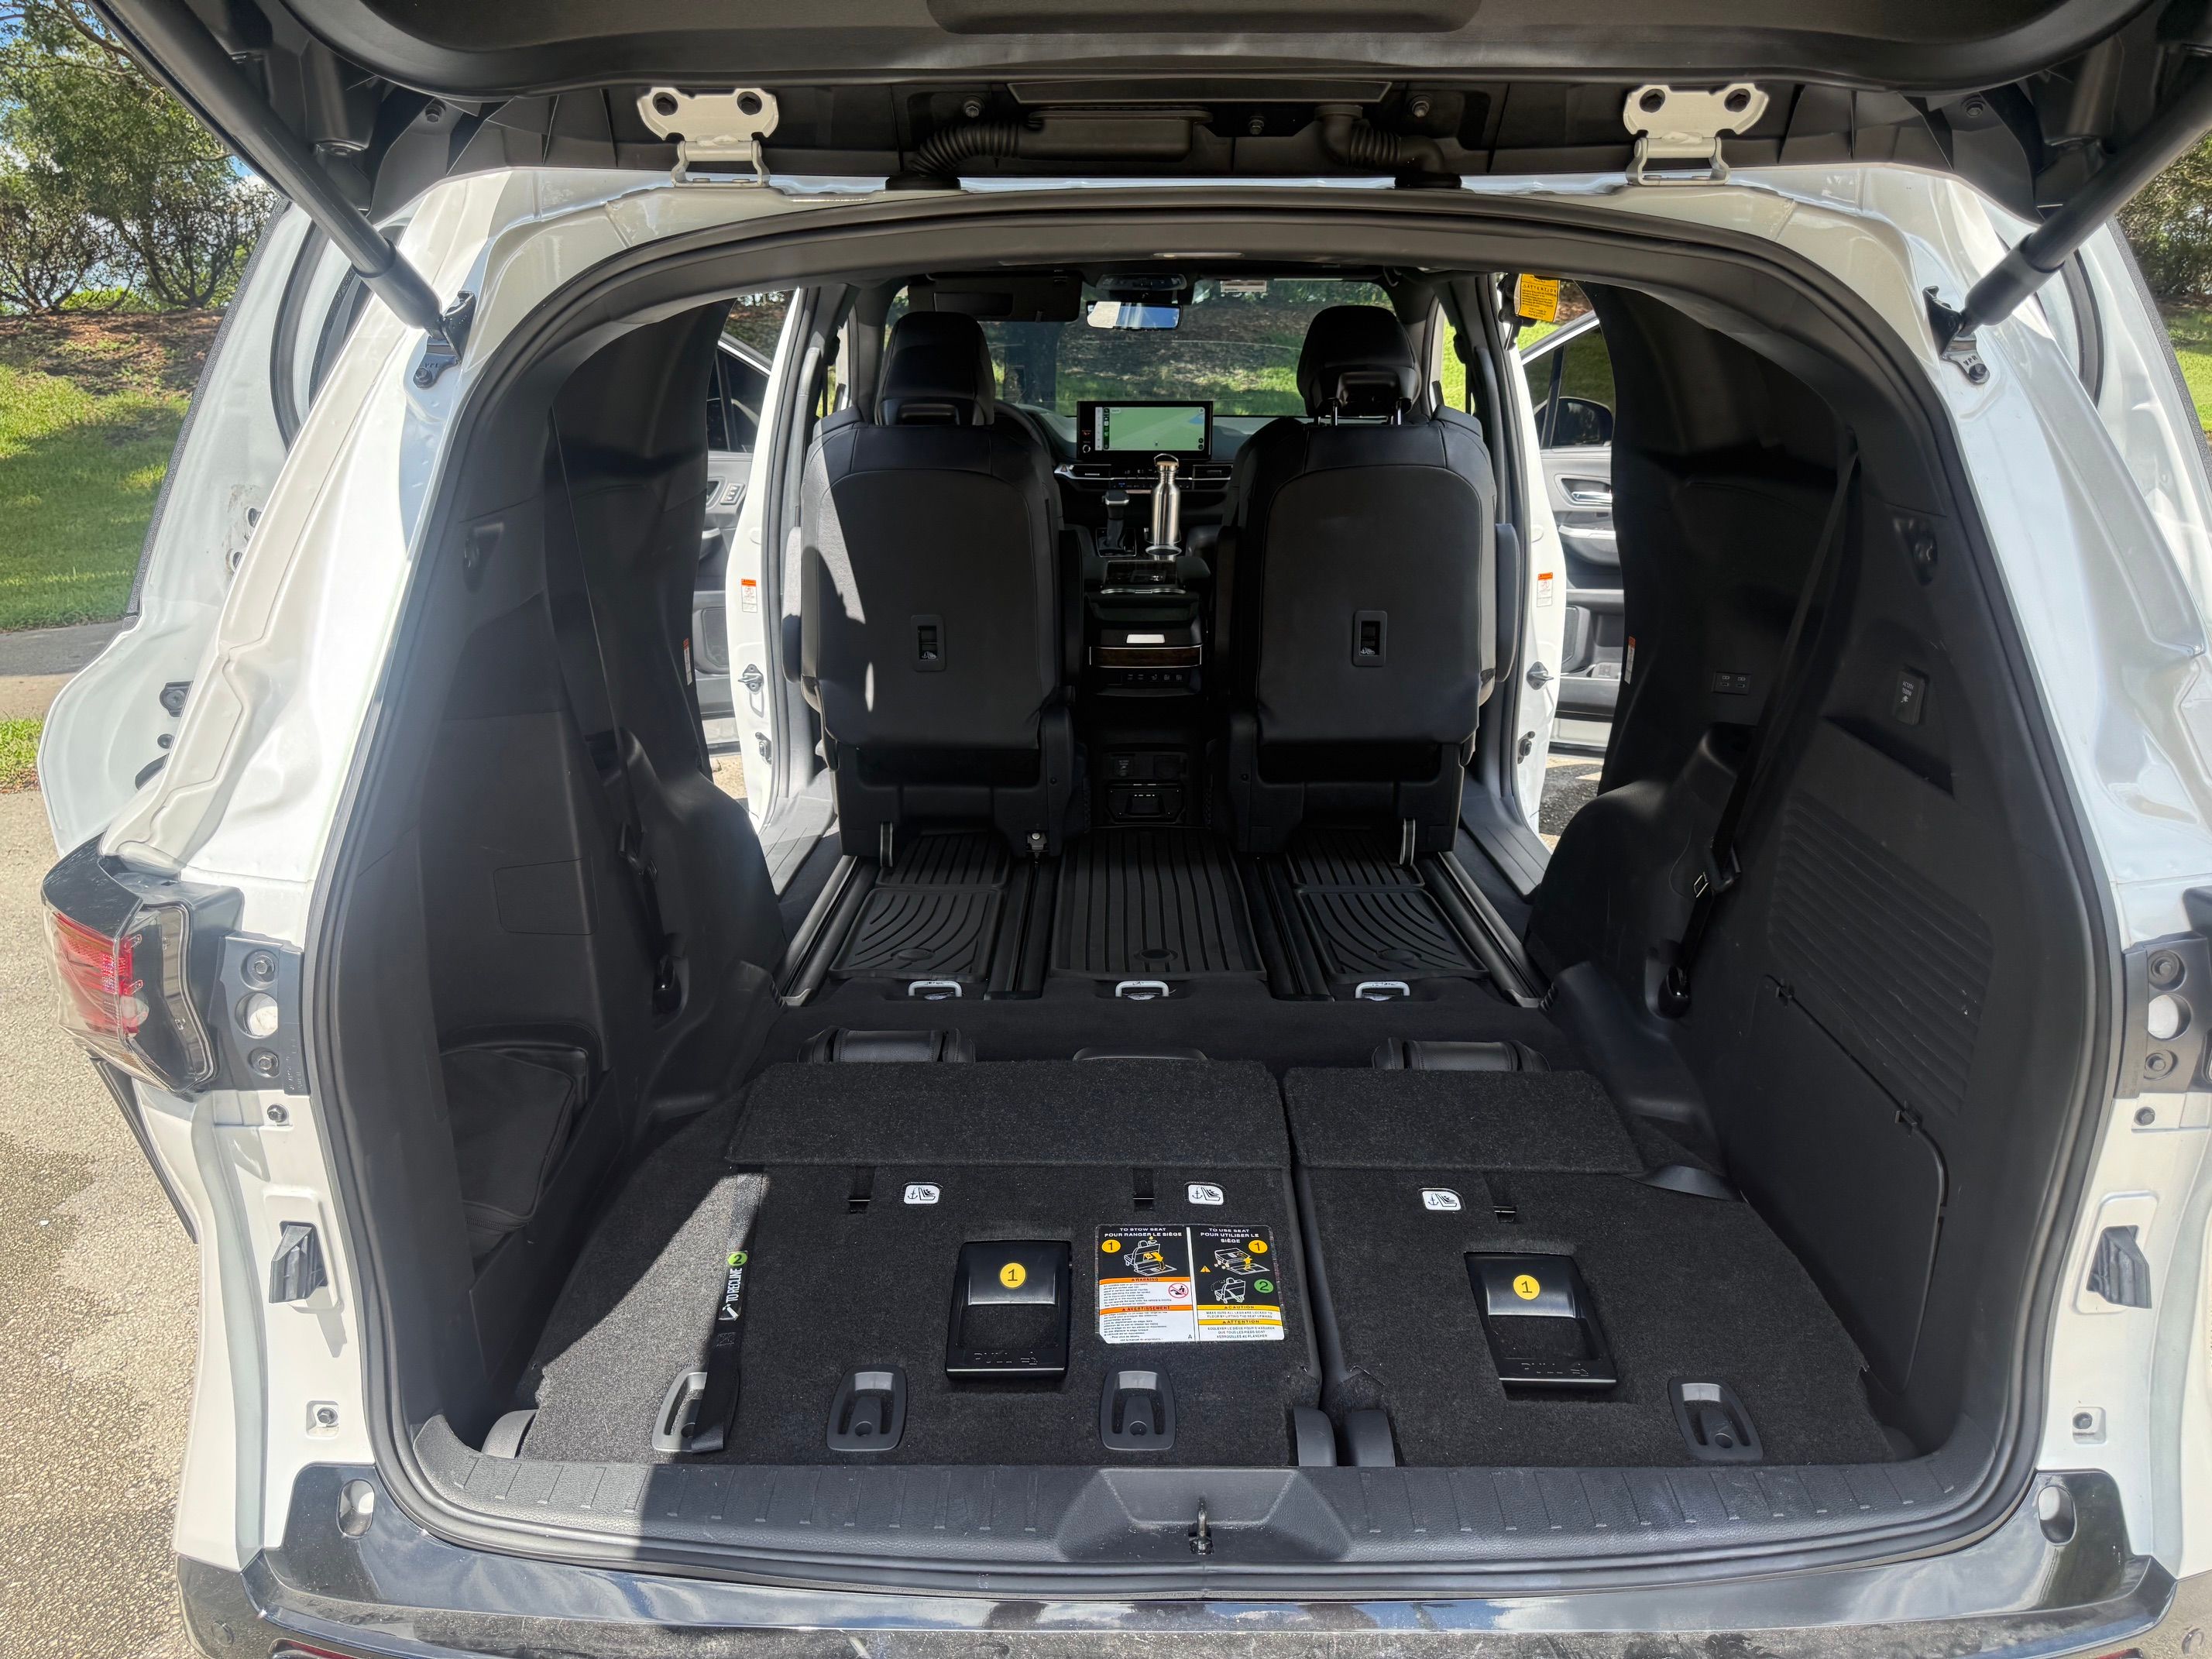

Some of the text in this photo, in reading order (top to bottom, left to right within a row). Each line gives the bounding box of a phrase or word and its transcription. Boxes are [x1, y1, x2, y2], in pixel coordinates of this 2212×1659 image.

[1108, 1242, 1113, 1251] 1
[1254, 1242, 1260, 1252] 1
[733, 1254, 743, 1265] 2
[1007, 1269, 1018, 1282] 1
[725, 1267, 743, 1304] TO RECLINE
[1259, 1280, 1269, 1291] 2
[1520, 1280, 1533, 1293] 1
